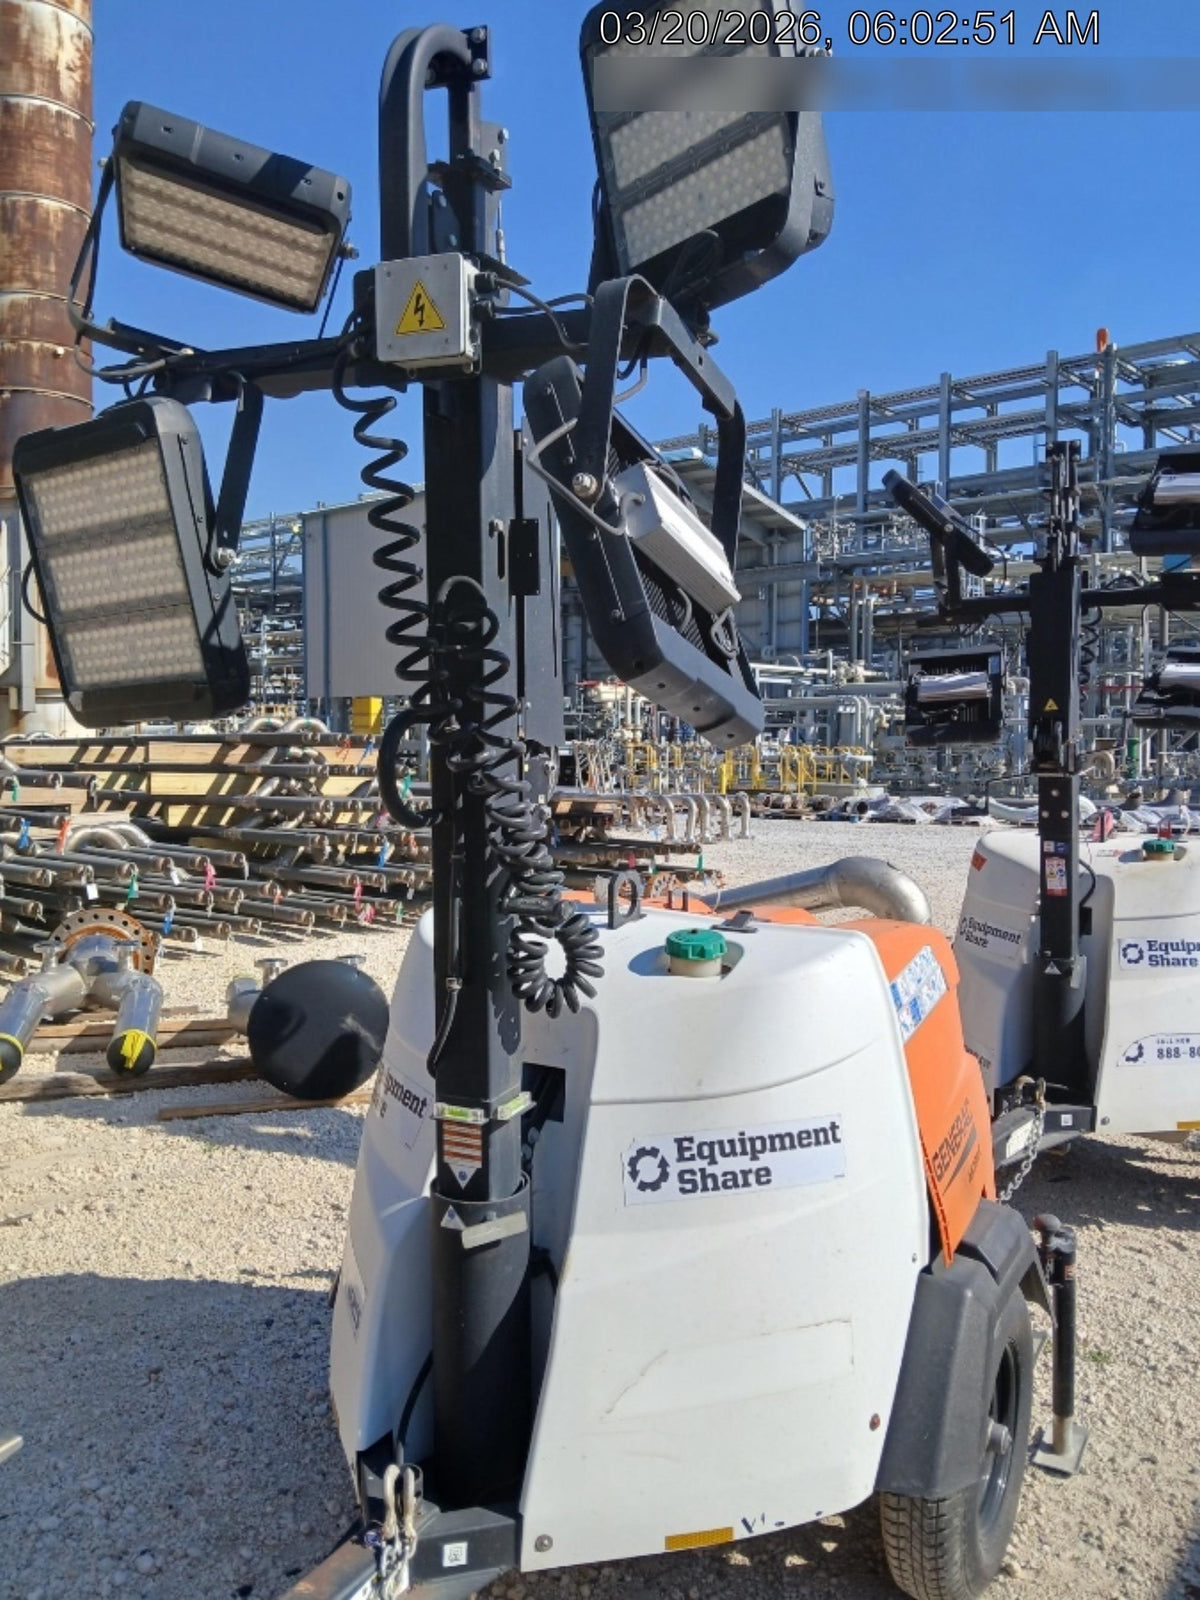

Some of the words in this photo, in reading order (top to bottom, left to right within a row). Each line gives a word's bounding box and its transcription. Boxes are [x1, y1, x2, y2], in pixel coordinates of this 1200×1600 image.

[1148, 954, 1199, 967] Share
[673, 1121, 842, 1166] Equipment
[677, 1166, 773, 1194] Share
